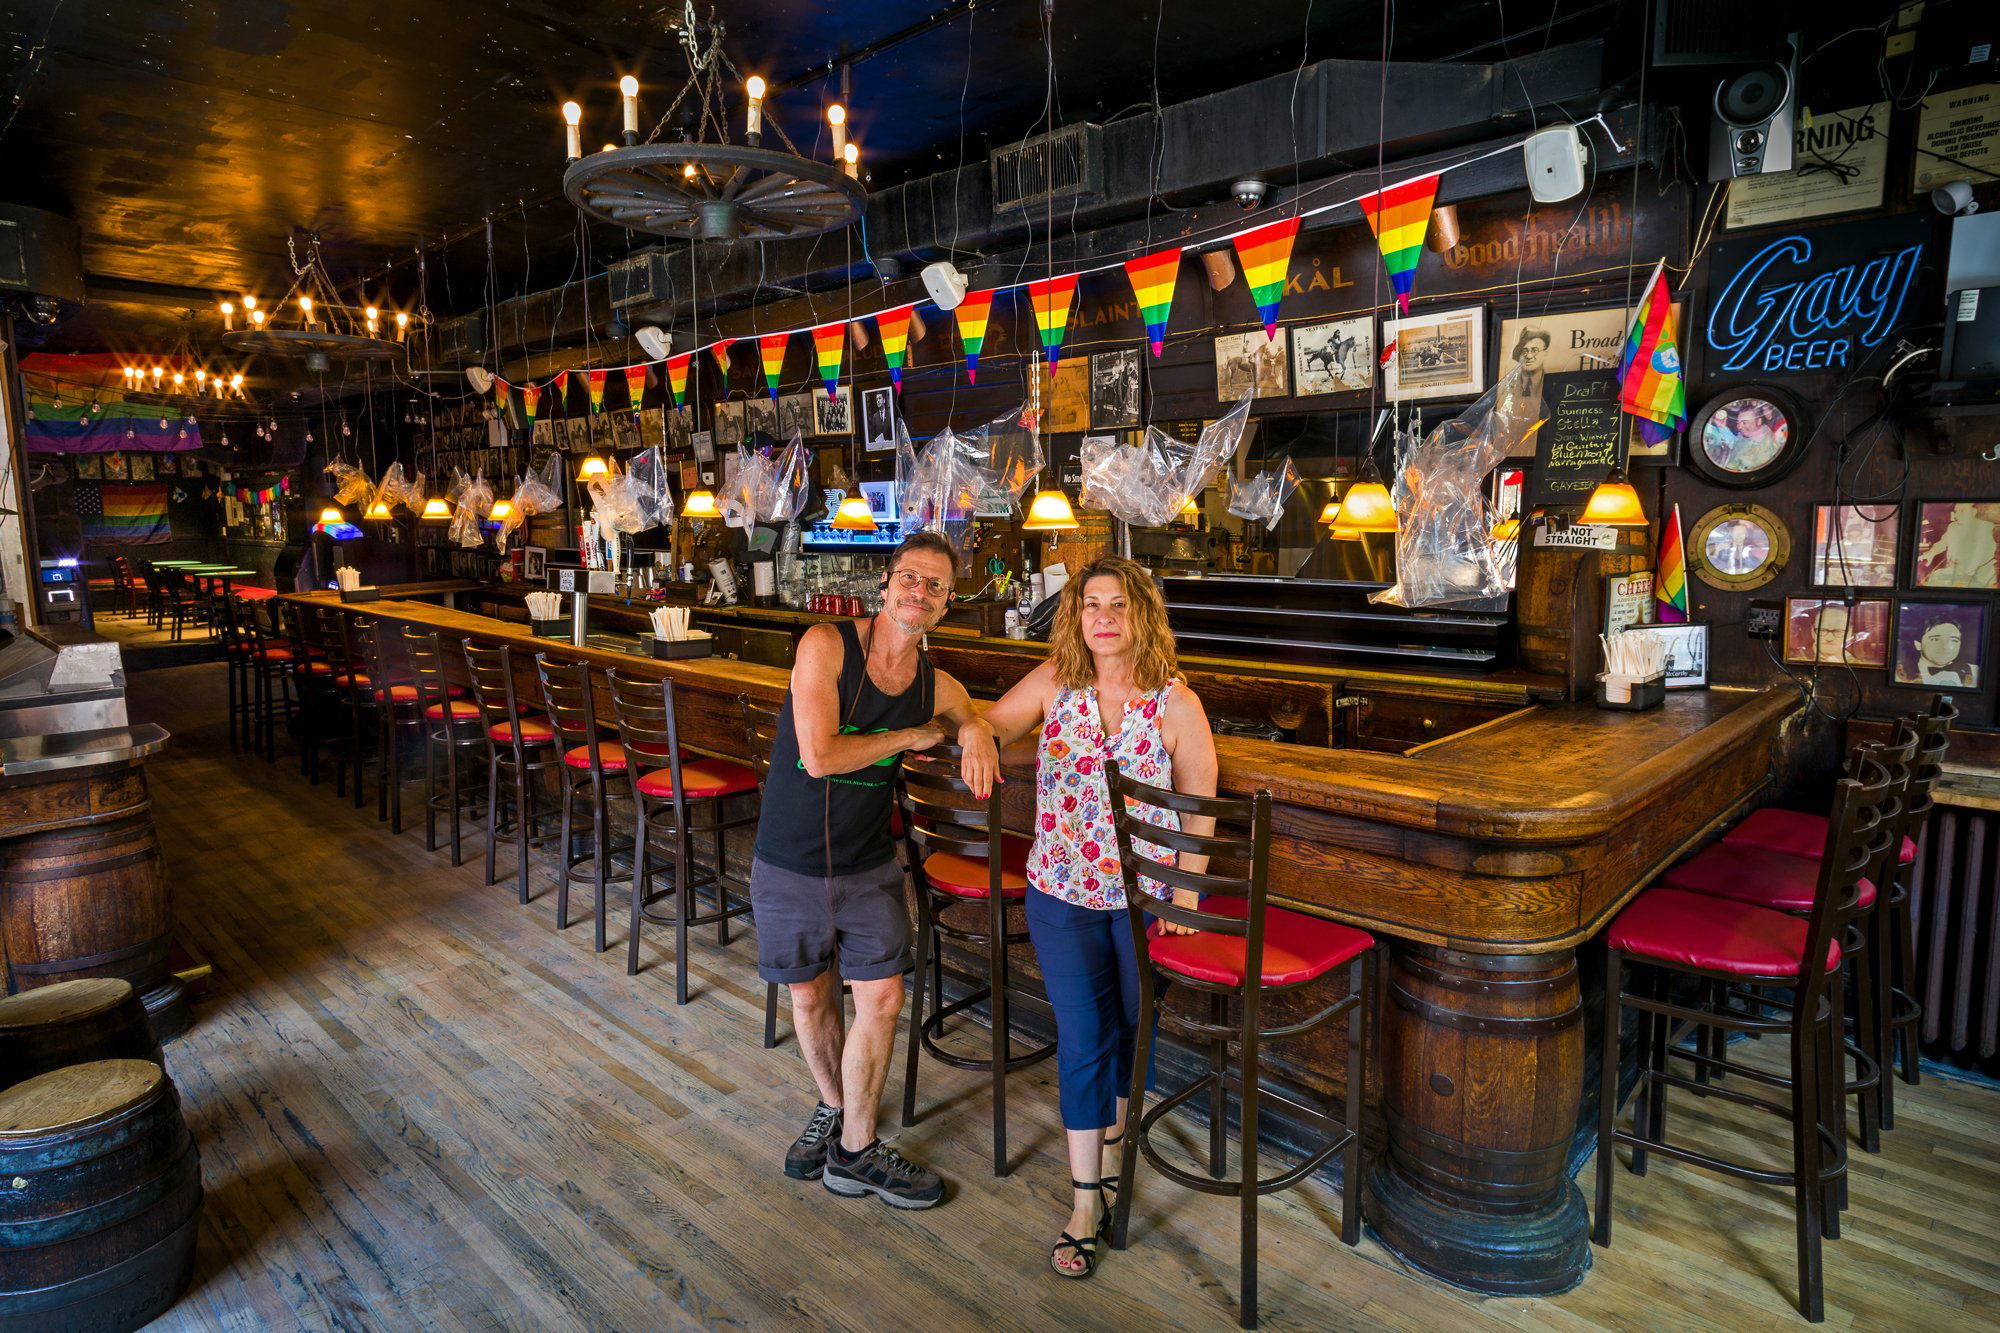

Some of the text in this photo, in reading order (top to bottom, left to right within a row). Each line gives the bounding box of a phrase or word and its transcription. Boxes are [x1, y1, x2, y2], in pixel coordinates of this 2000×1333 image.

[1949, 94, 1990, 109] WARNING
[1949, 115, 1984, 128] DRINKING
[1796, 115, 1875, 153] RNING
[1927, 120, 2000, 141] ALCOHOLIC BEVERAGE
[1931, 129, 1999, 148] DURING PREGNANCY
[1945, 139, 1984, 153] CAN CAUSE
[1959, 146, 1989, 158] DEFECTS
[1443, 221, 1521, 270] Good
[1282, 256, 1354, 297] KÅL
[1707, 234, 1924, 371] Gay
[1569, 329, 1624, 349] Broad
[1763, 338, 1850, 371] BEER
[1557, 403, 1604, 416] Guinness
[1557, 416, 1619, 431] Stella 7
[1608, 431, 1619, 442] 7
[1570, 527, 1593, 537] NOT
[1545, 535, 1599, 546] STRAIGHT
[1617, 579, 1653, 596] CHEER
